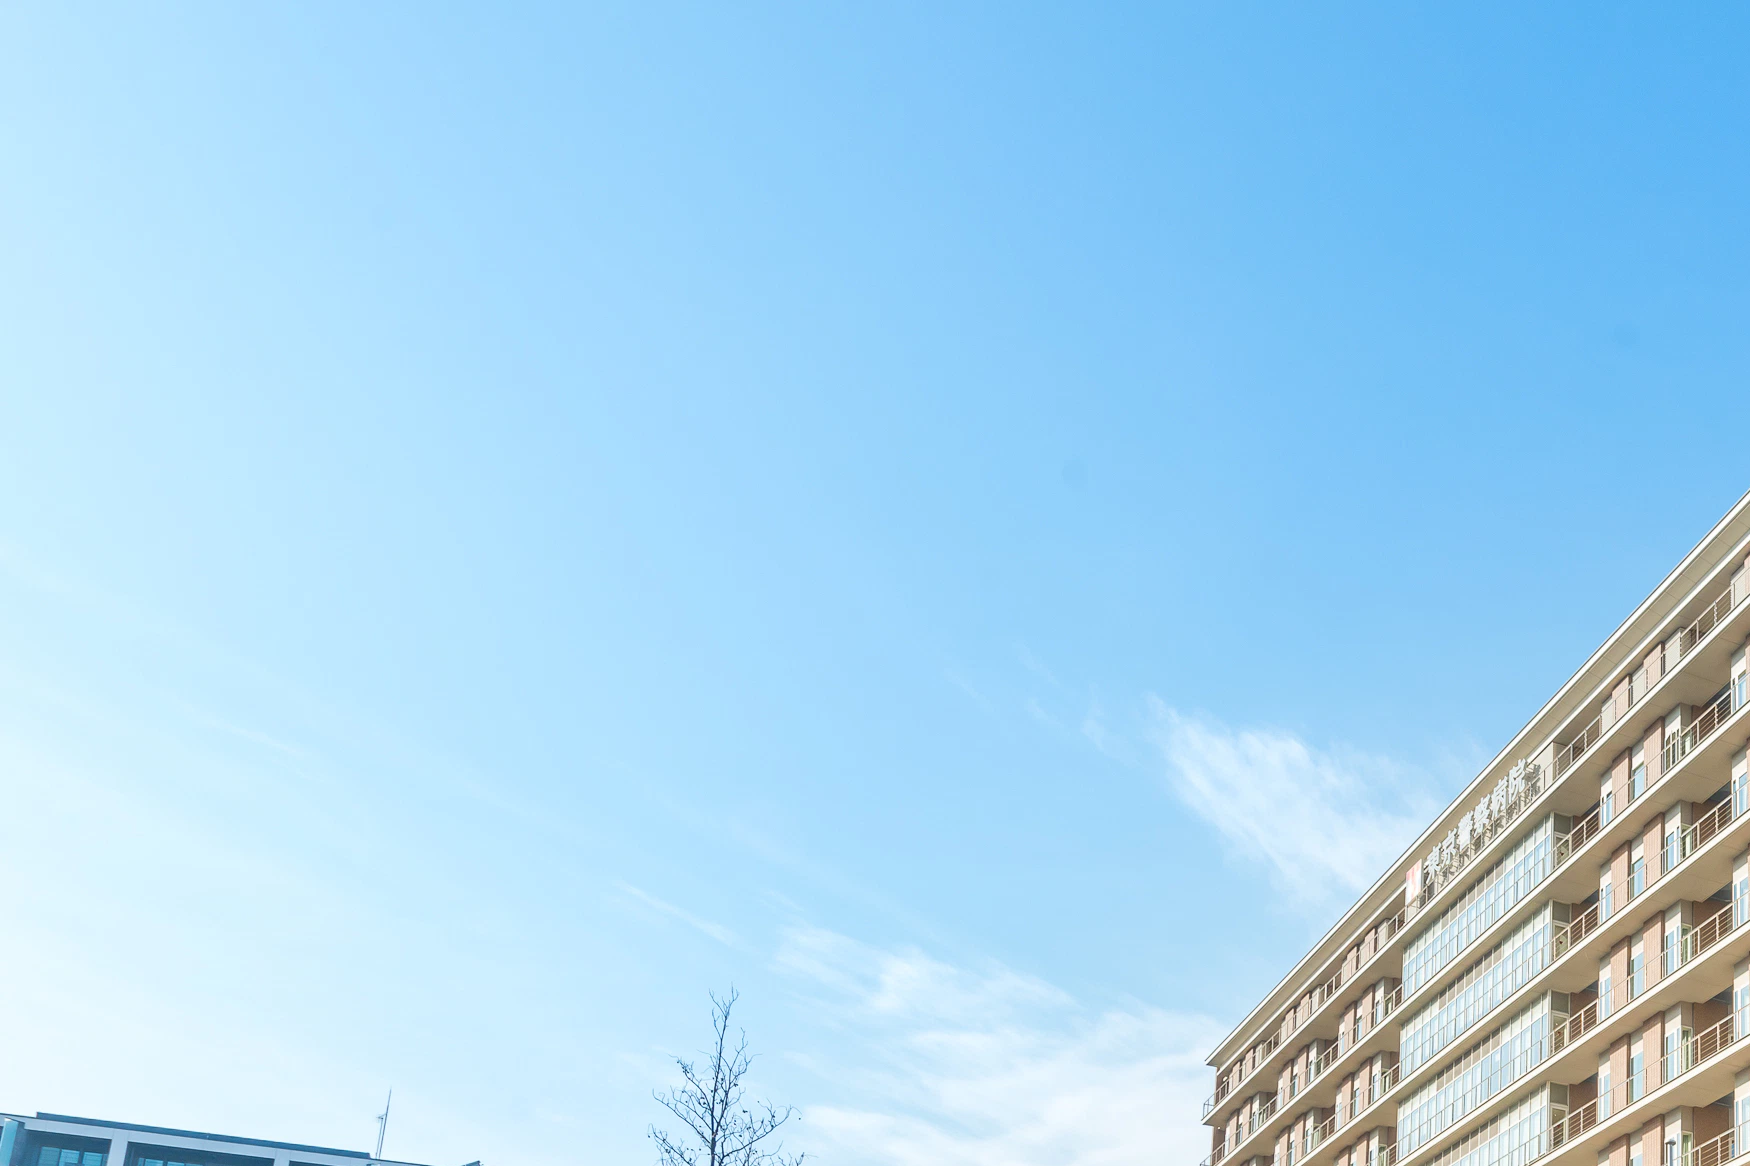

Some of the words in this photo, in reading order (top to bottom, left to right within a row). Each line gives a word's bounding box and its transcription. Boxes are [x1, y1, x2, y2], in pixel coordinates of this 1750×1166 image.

[1423, 758, 1526, 885] 東京警察病院
